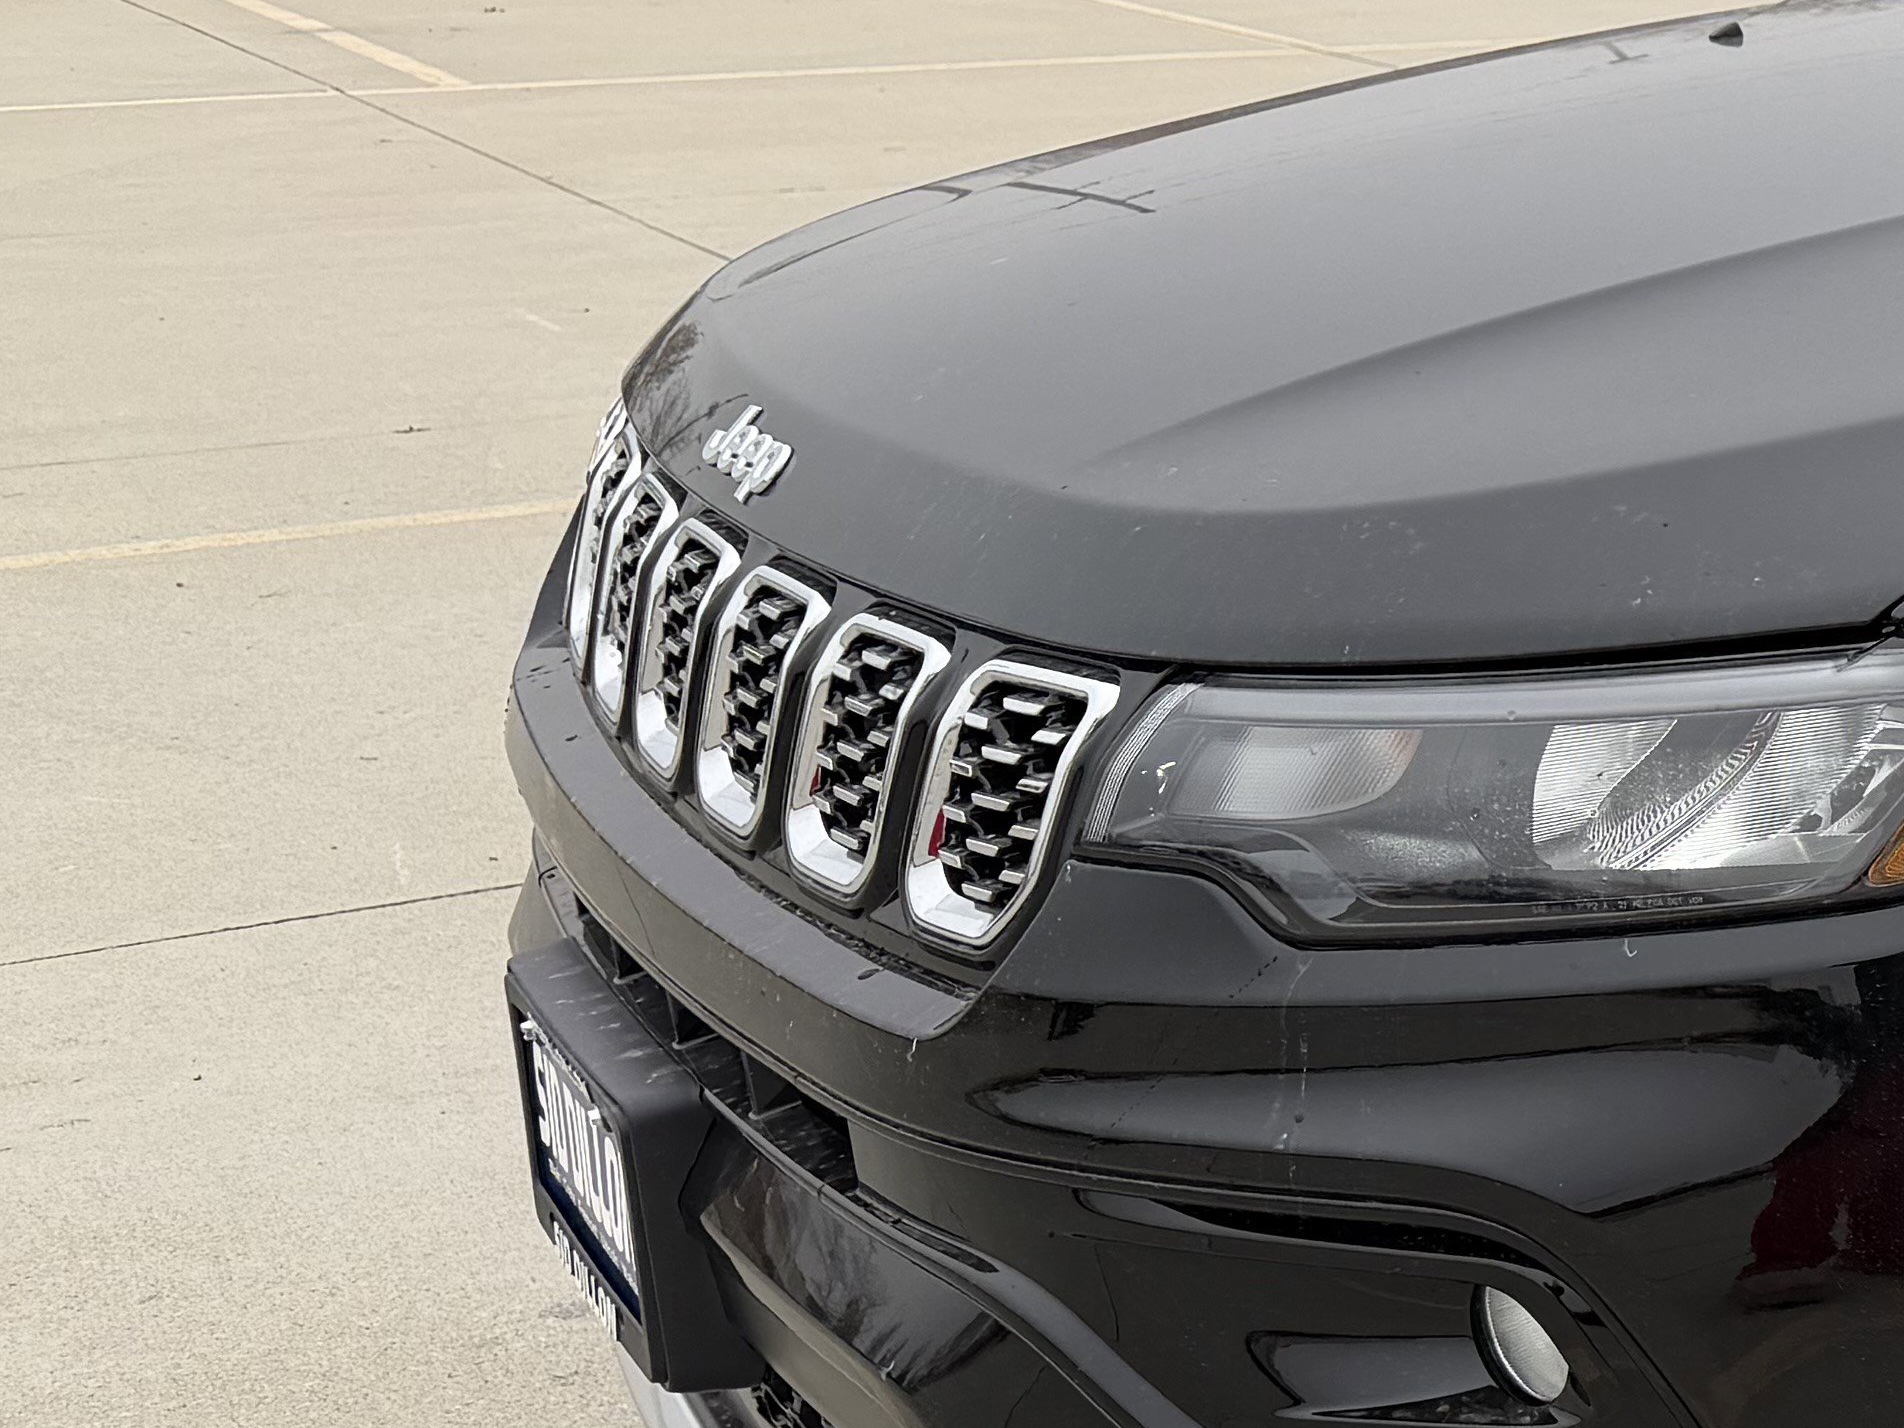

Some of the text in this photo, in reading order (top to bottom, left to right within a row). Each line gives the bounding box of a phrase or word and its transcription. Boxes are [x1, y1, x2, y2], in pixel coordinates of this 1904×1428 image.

[702, 405, 793, 504] Jeep
[533, 1041, 636, 1271] SID DILLON
[553, 1221, 617, 1341] SID DILLON
